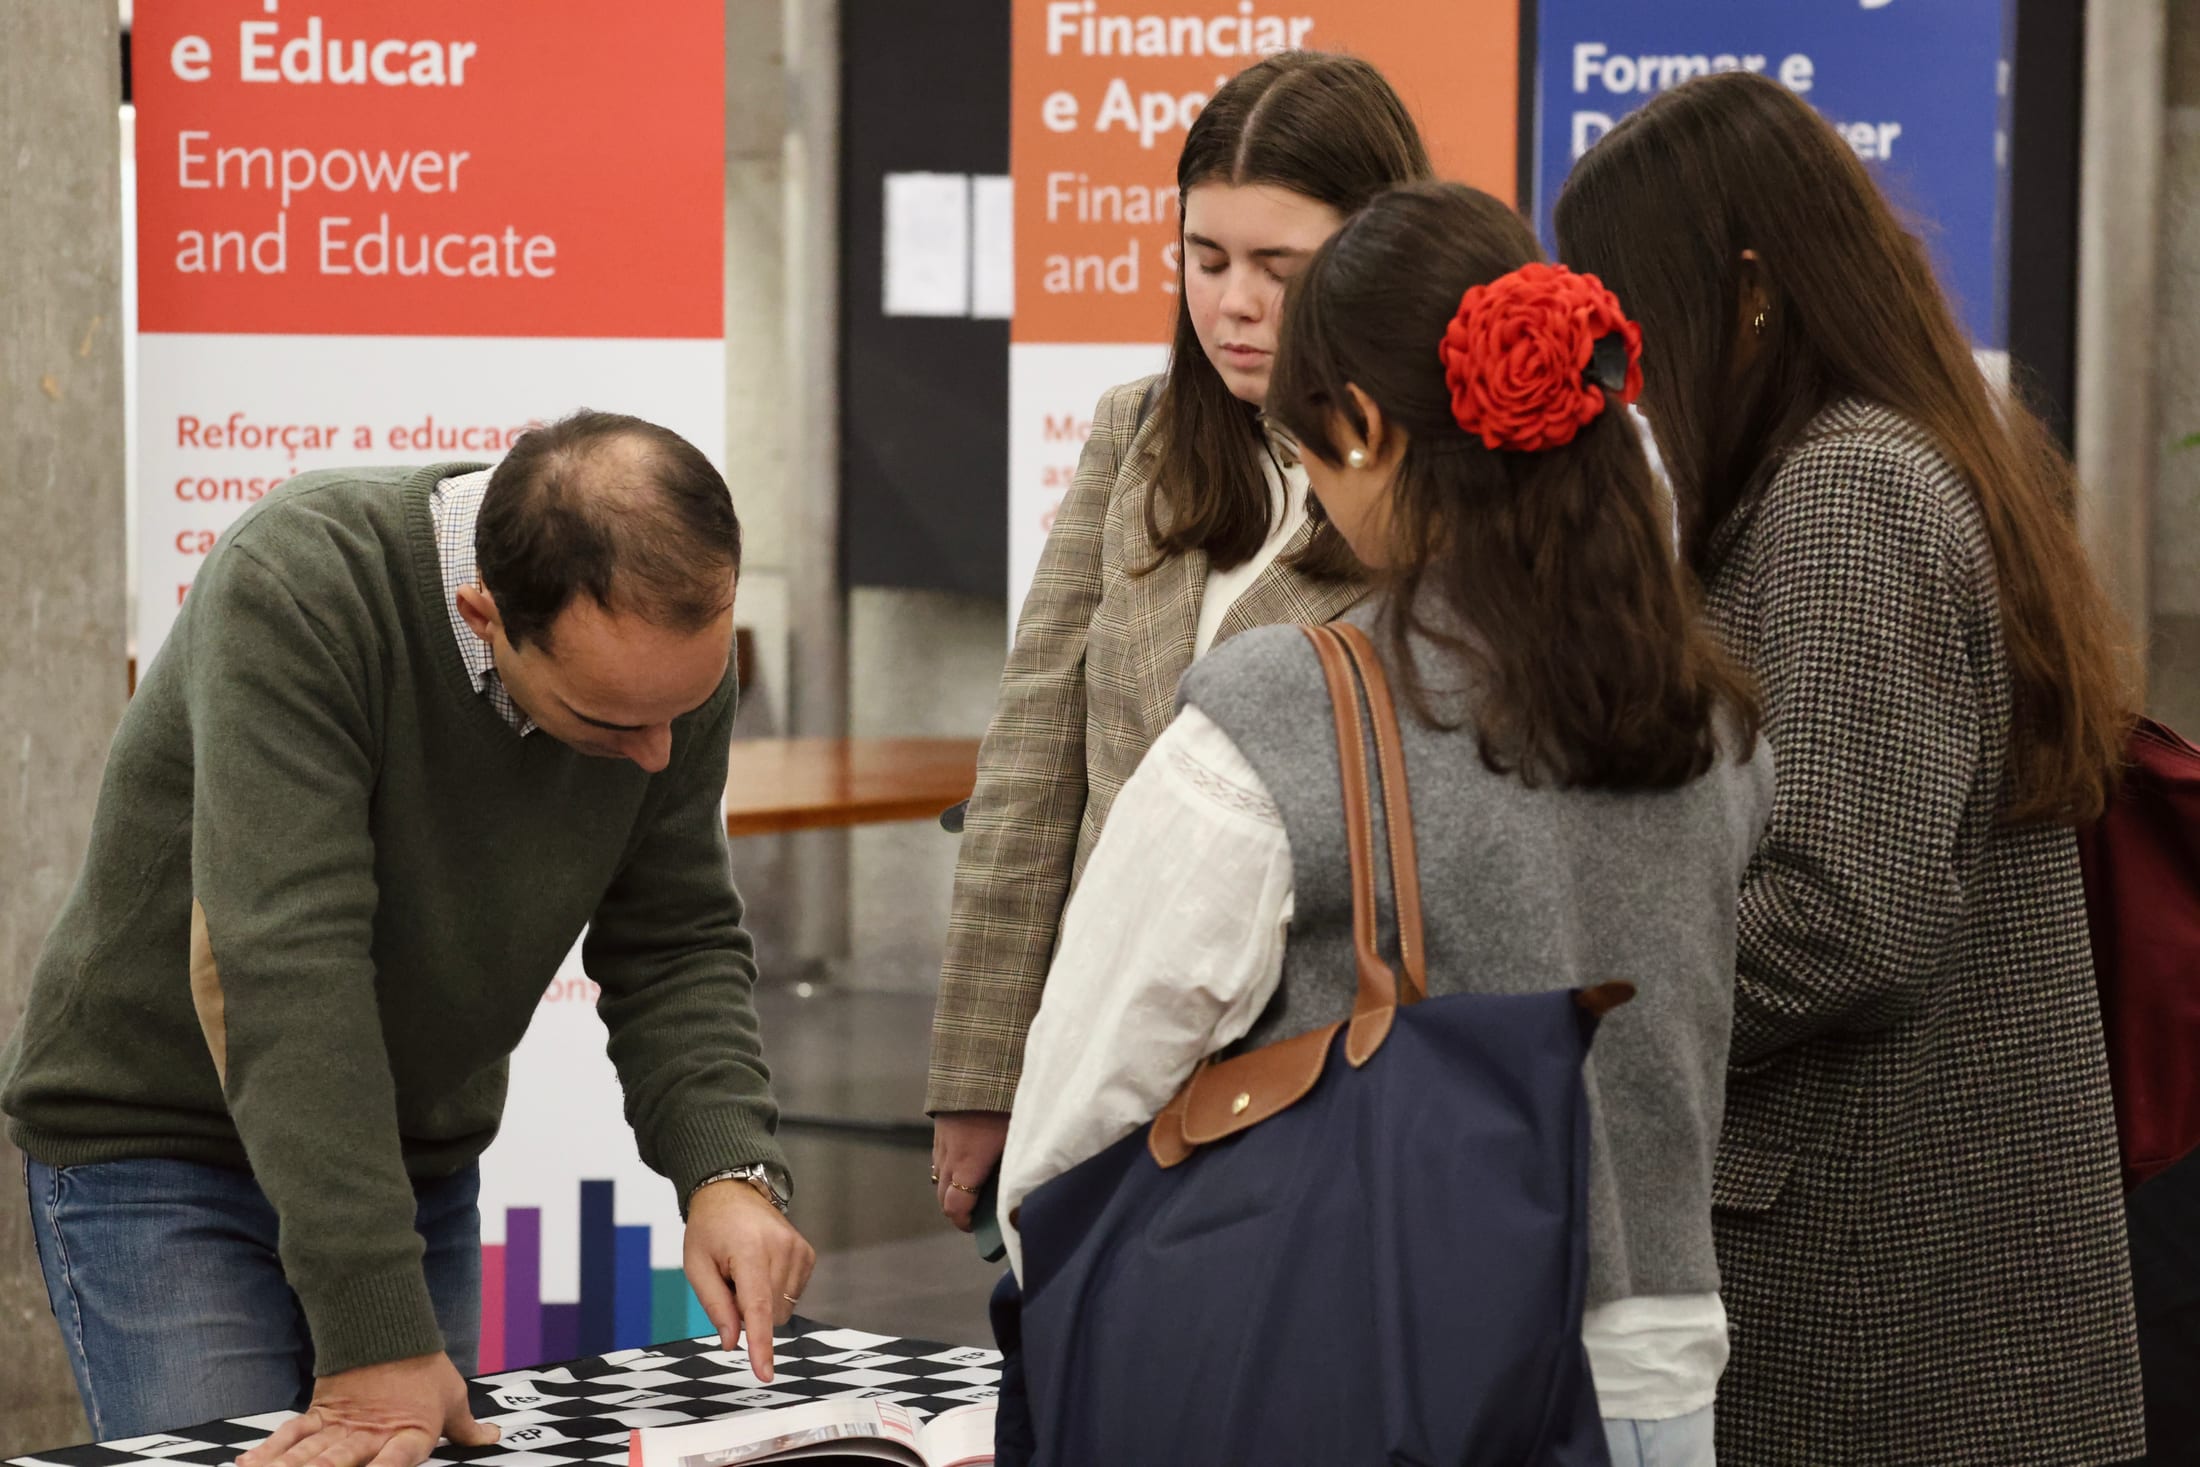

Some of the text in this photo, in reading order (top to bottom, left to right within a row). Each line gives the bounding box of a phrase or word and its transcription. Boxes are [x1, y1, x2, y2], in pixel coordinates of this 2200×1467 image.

[171, 16, 477, 86] e Educar
[1046, 0, 1314, 56] Financiar
[1778, 52, 1815, 93] e
[1042, 77, 1210, 149] e Apo
[178, 130, 470, 208] Empower
[175, 210, 557, 278] and Educate
[1043, 238, 1139, 294] and
[177, 411, 339, 461] Reforçar
[353, 424, 373, 450] a
